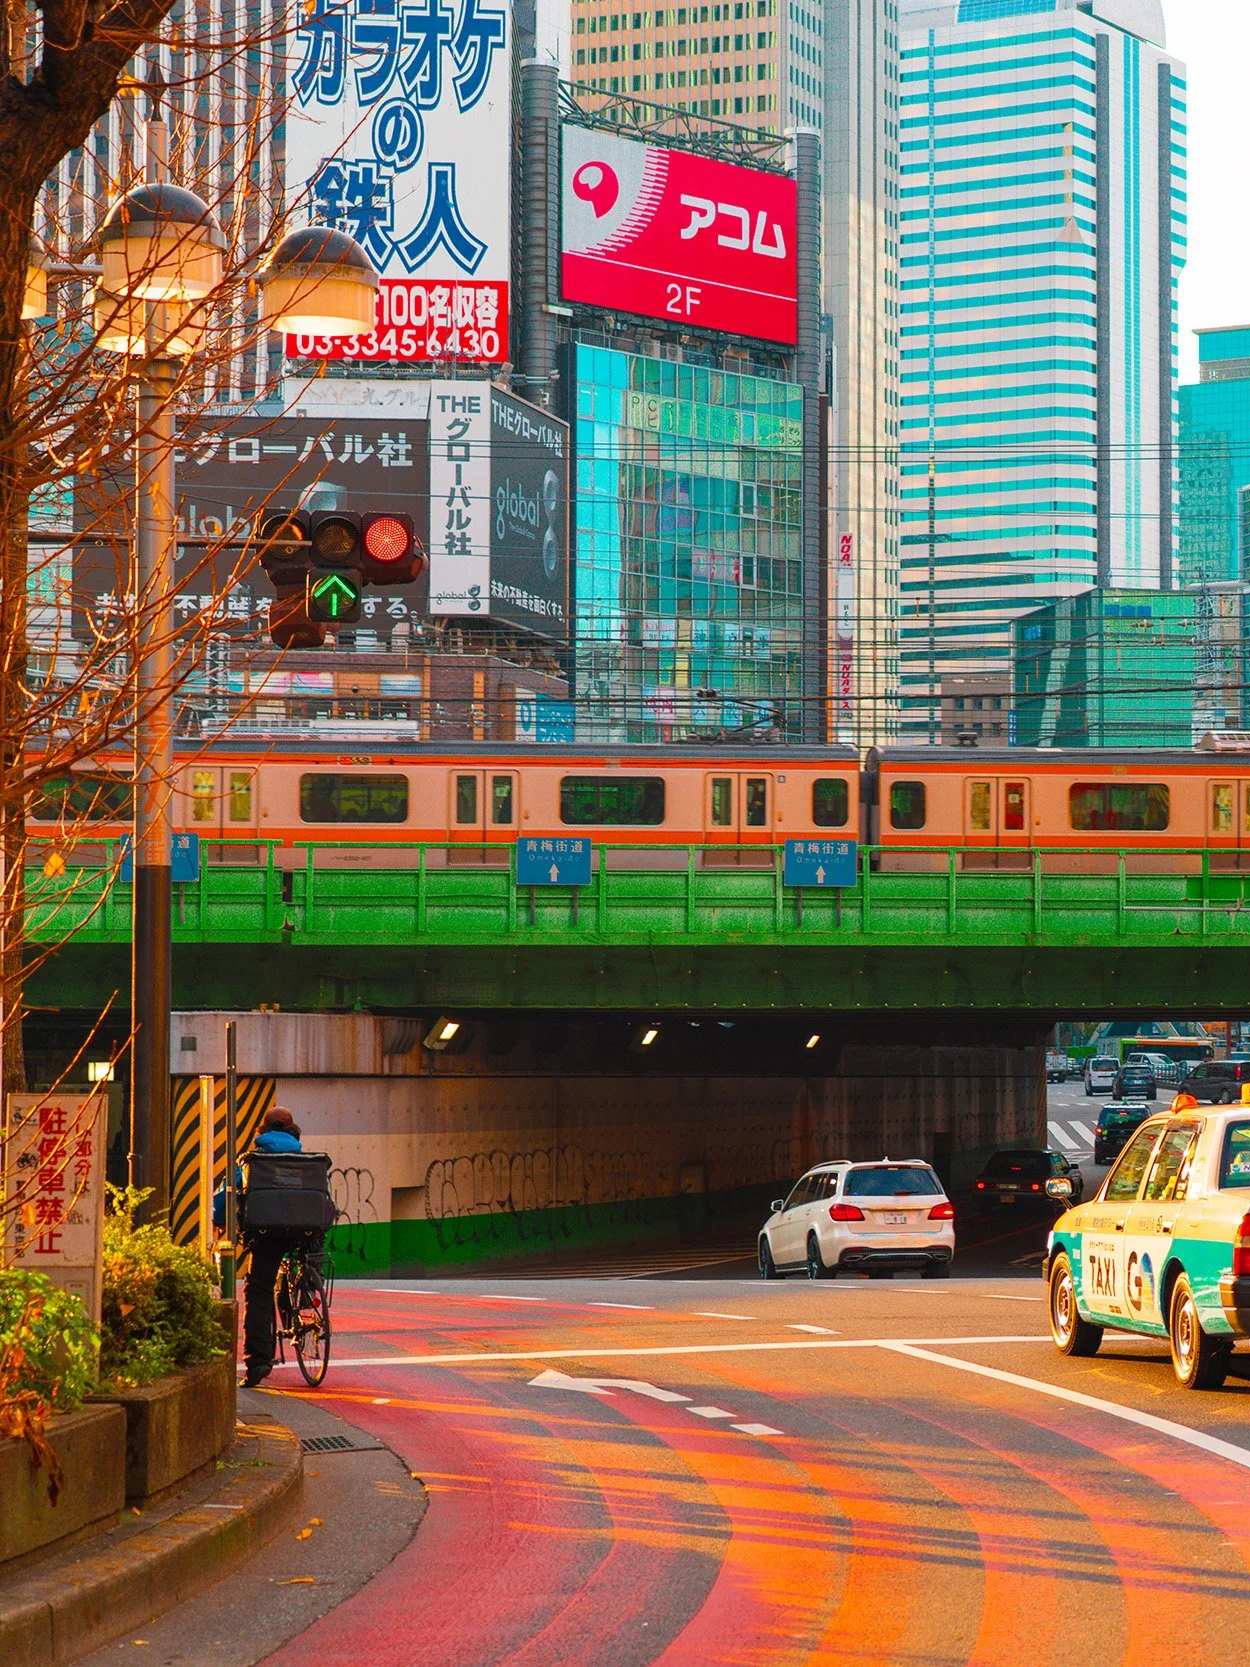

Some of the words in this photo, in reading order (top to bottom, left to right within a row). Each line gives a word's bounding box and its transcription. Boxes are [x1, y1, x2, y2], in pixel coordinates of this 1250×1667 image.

[291, 0, 507, 114] カラオケ
[372, 97, 424, 173] の
[306, 159, 489, 276] 鉄人
[680, 194, 787, 259] アコム
[373, 284, 499, 329] 100名収容
[666, 283, 702, 316] 2F
[296, 328, 500, 359] 03-3345-6430
[436, 395, 481, 414] THE
[492, 399, 563, 458] THEグローバル社
[445, 418, 472, 556] グローバル社
[496, 478, 540, 540] global
[526, 840, 584, 854] 青梅街道
[793, 842, 850, 856] 青梅街道
[34, 1107, 67, 1254] 駐停車禁止
[1089, 1255, 1117, 1297] TAXI
